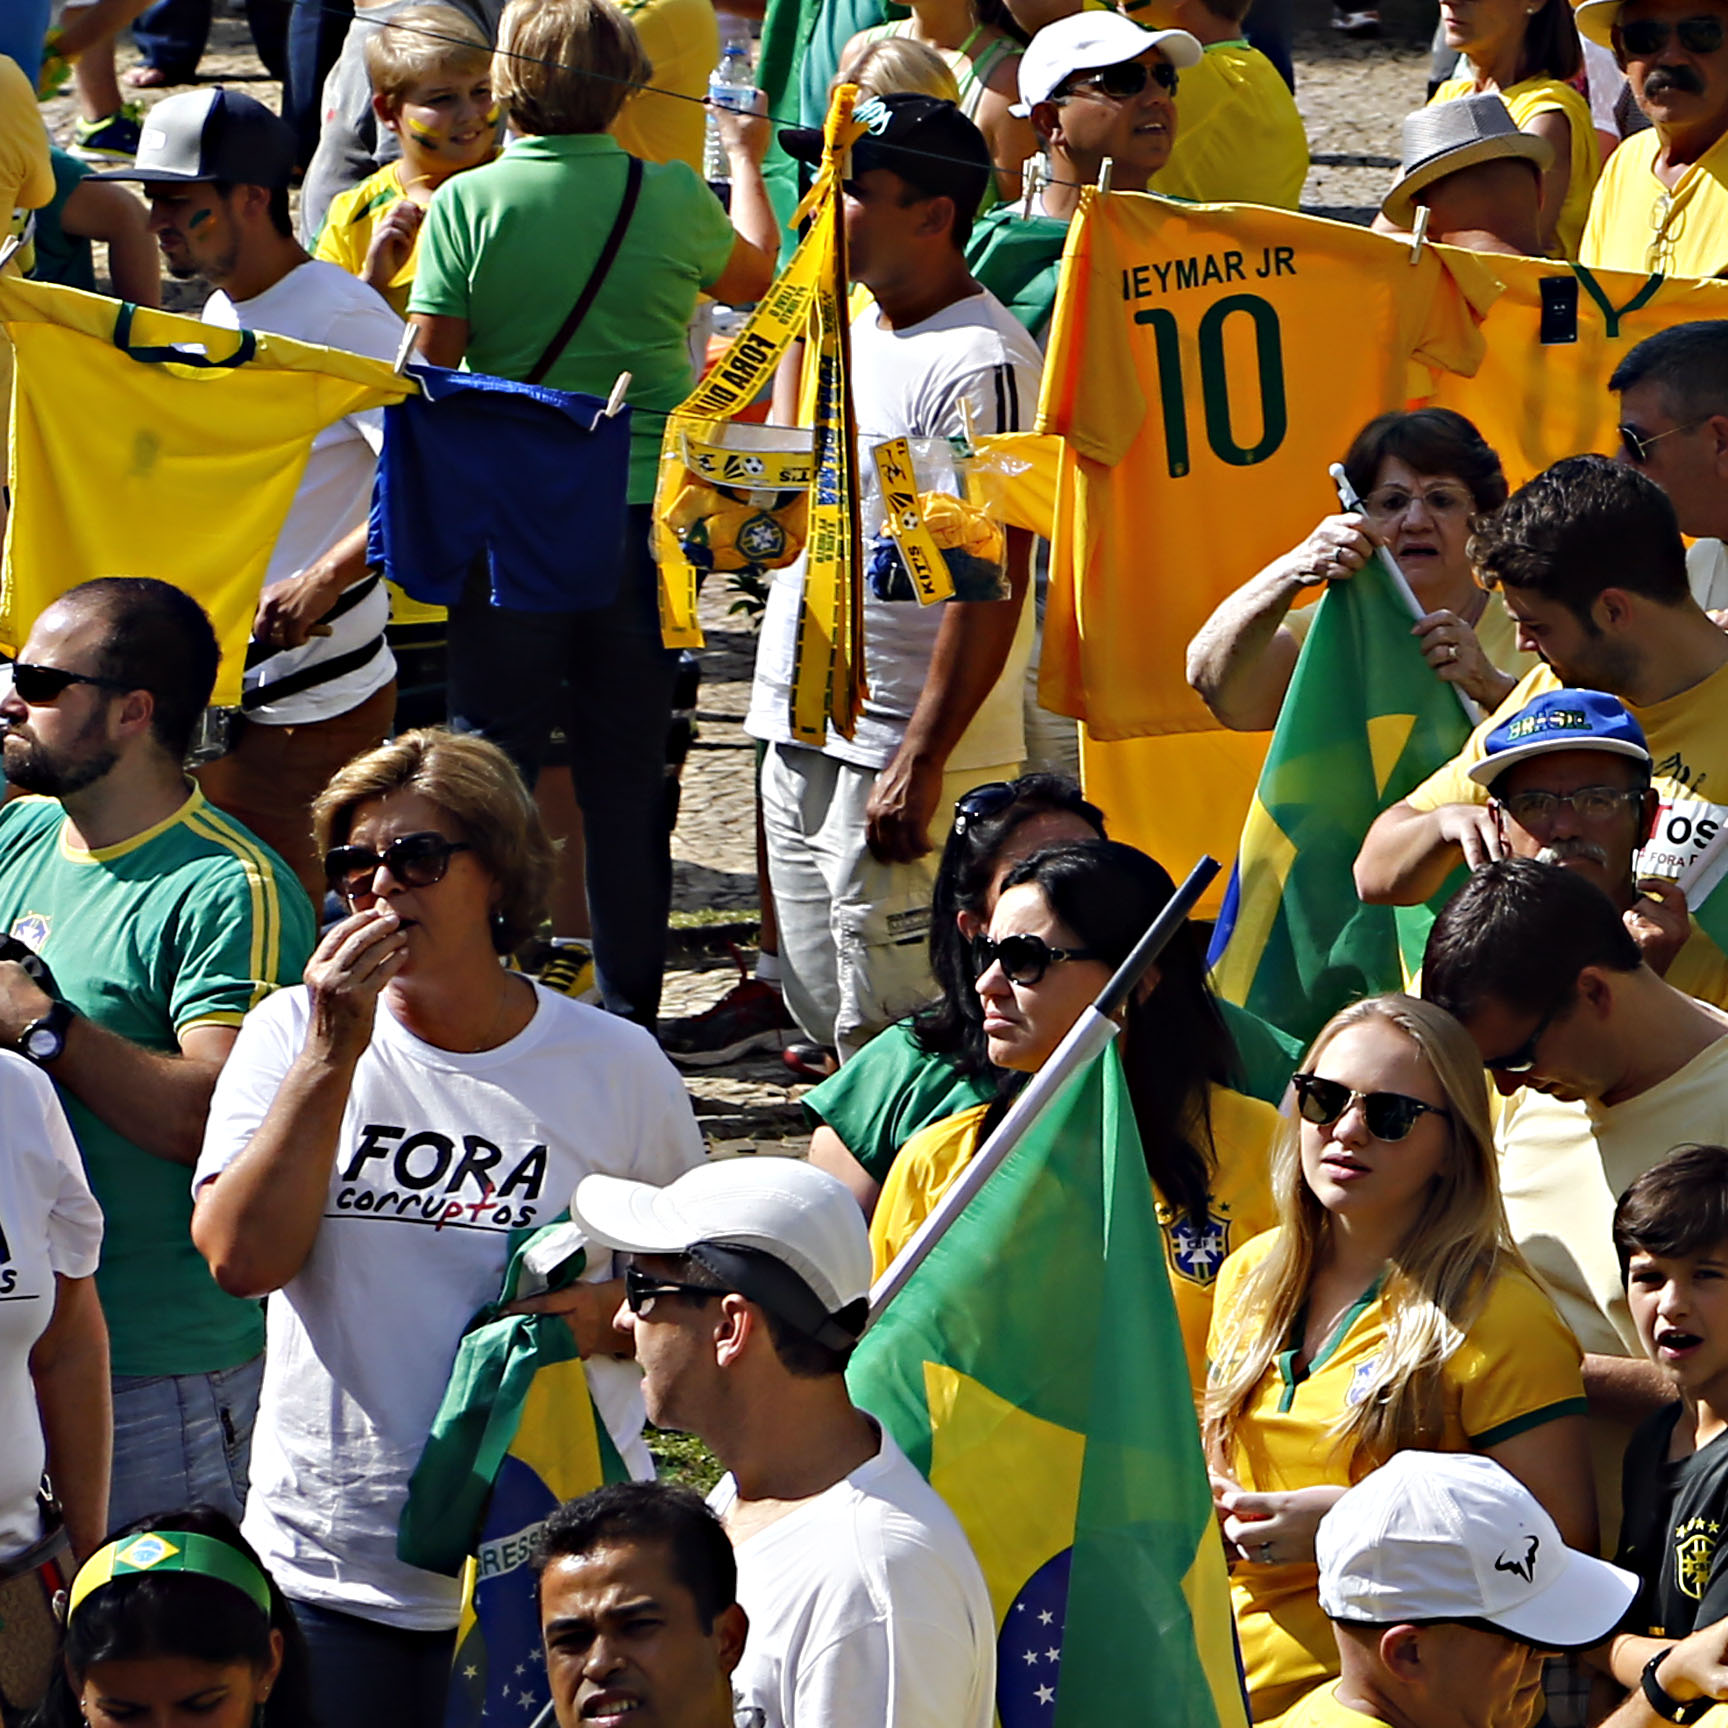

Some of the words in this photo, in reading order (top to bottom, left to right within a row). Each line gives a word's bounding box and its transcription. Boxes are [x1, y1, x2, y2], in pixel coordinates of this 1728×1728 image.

[1255, 245, 1299, 278] JR
[1133, 292, 1290, 479] 10
[907, 545, 937, 595] KIT'S
[1506, 709, 1592, 742] BRASIL
[343, 1124, 549, 1199] FORA
[337, 1182, 537, 1232] corruptos
